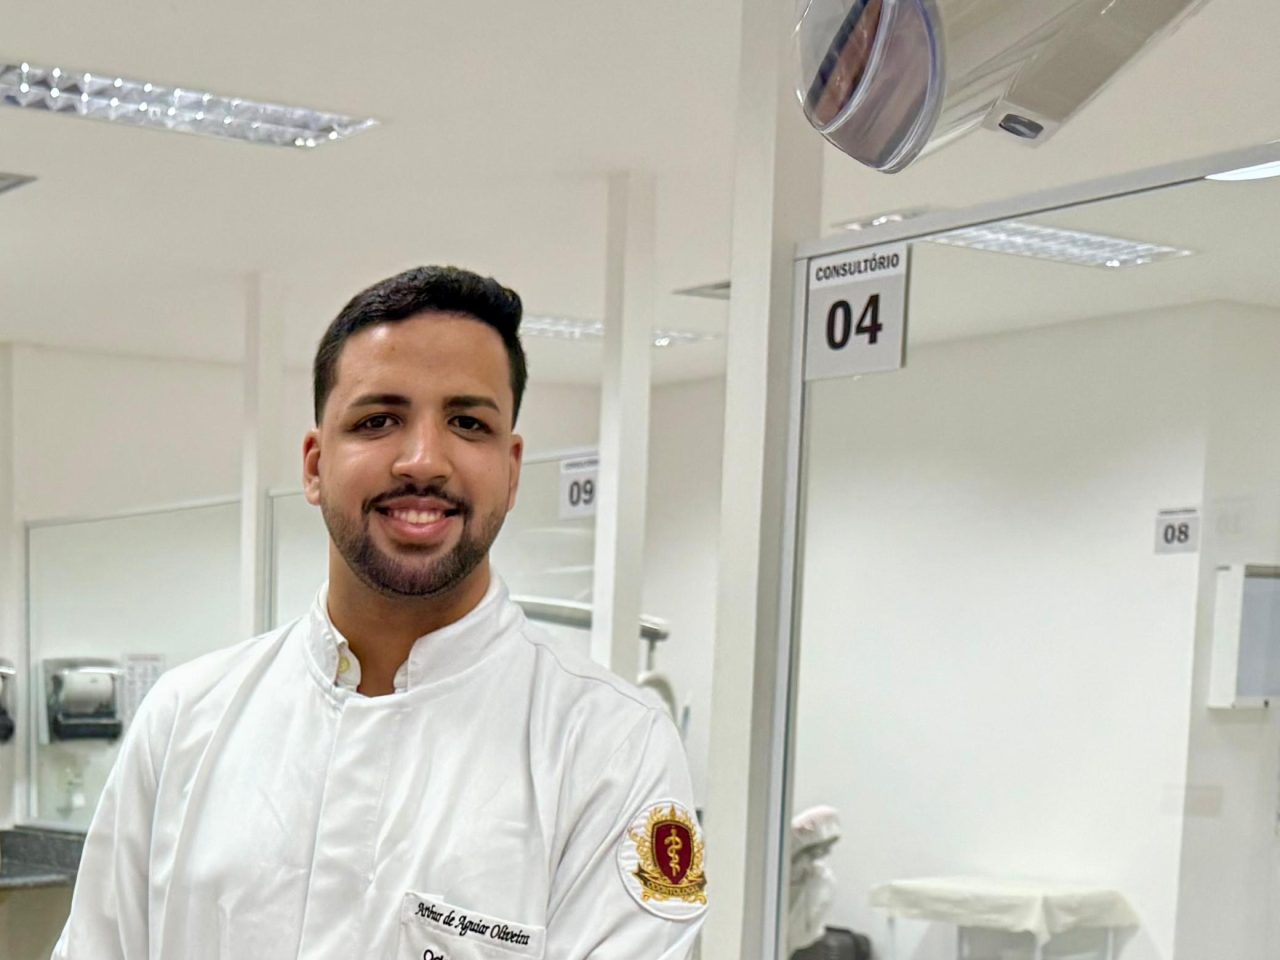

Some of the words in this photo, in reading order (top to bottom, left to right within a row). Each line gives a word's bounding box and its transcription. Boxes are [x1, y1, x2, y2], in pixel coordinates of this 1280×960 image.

[815, 252, 900, 281] CONSULTÓRIO
[826, 293, 883, 351] 04
[568, 479, 595, 507] 09
[1163, 522, 1190, 545] 08
[442, 910, 456, 927] de
[454, 914, 490, 937] Aguiar
[489, 923, 531, 946] Oliveira
